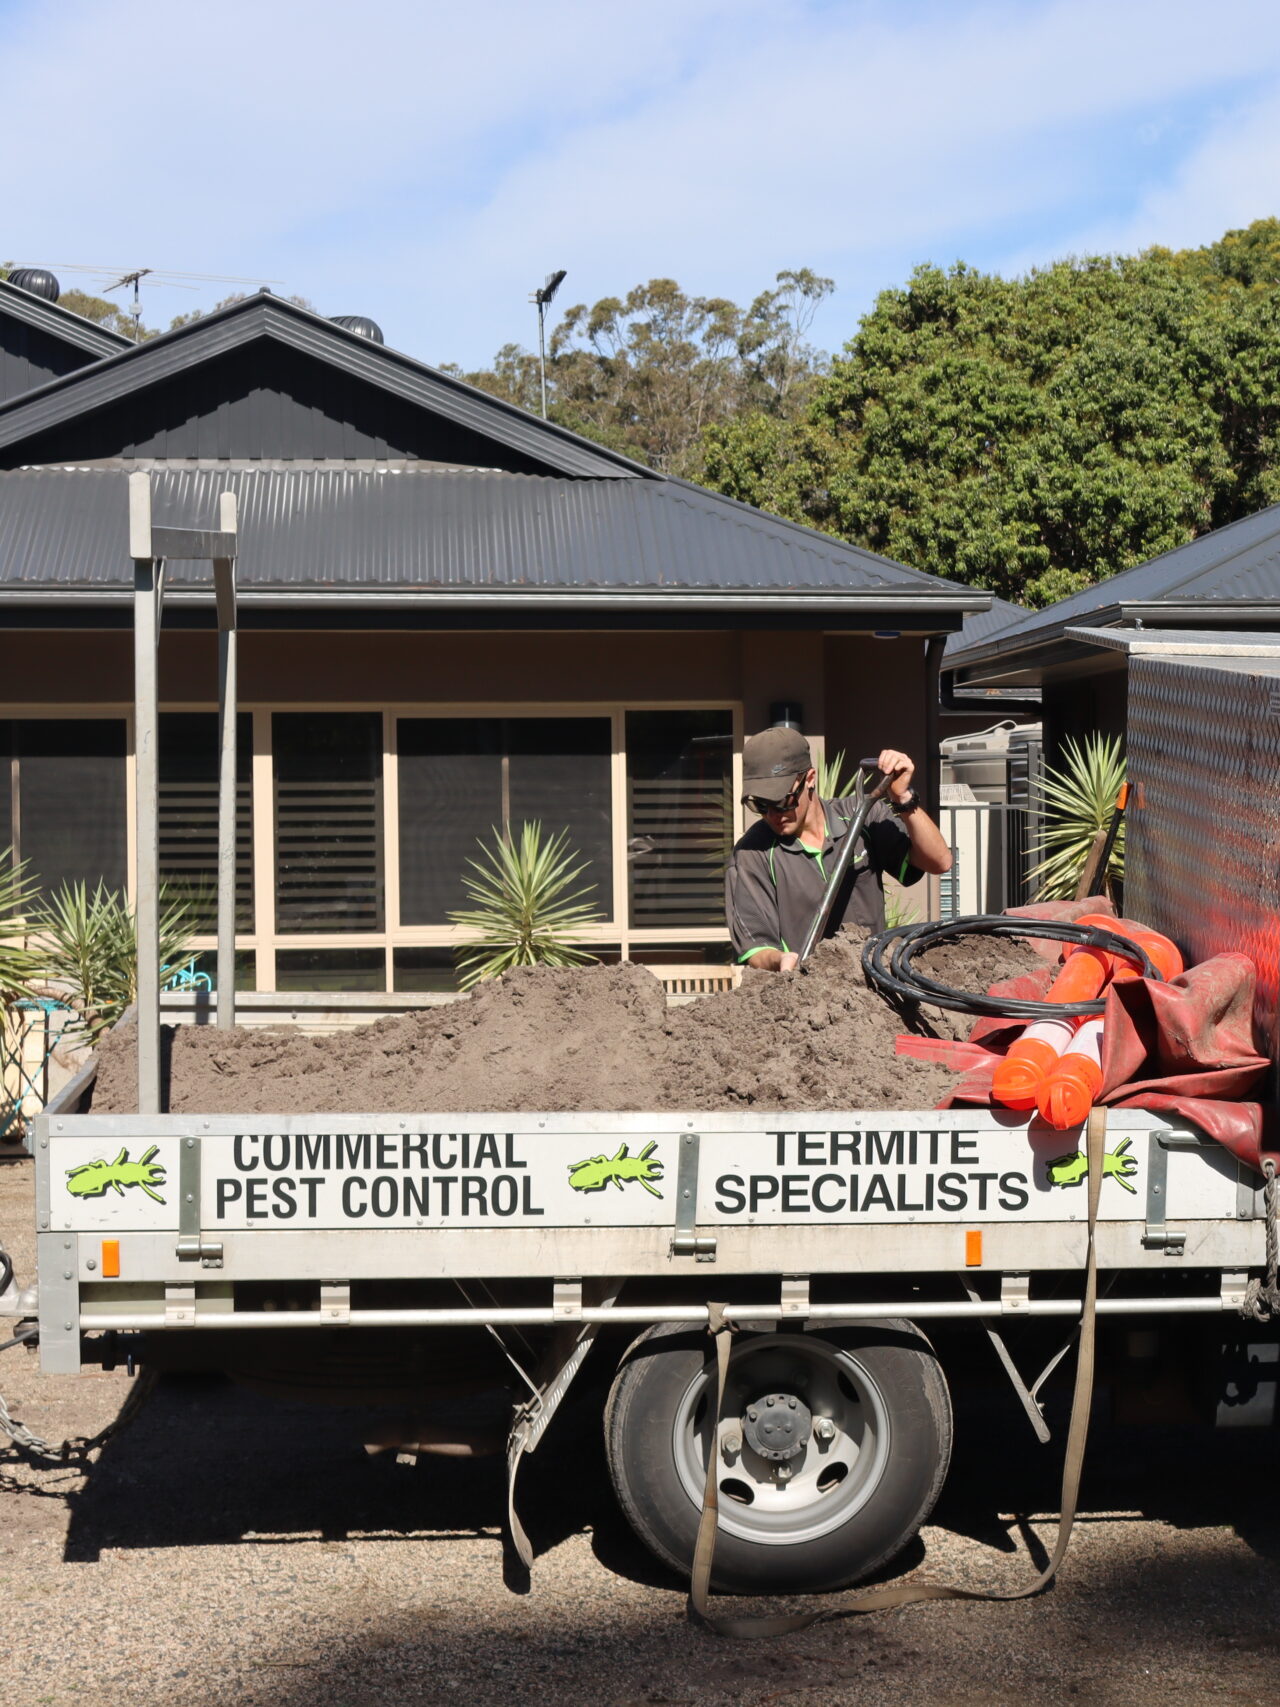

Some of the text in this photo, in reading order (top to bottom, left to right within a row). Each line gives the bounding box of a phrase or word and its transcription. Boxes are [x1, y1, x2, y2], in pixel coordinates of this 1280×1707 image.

[233, 1133, 527, 1171] COMMERCIAL
[766, 1130, 980, 1166] TERMITE
[216, 1175, 544, 1219] PEST CONTROL
[714, 1172, 1029, 1214] SPECIALISTS
